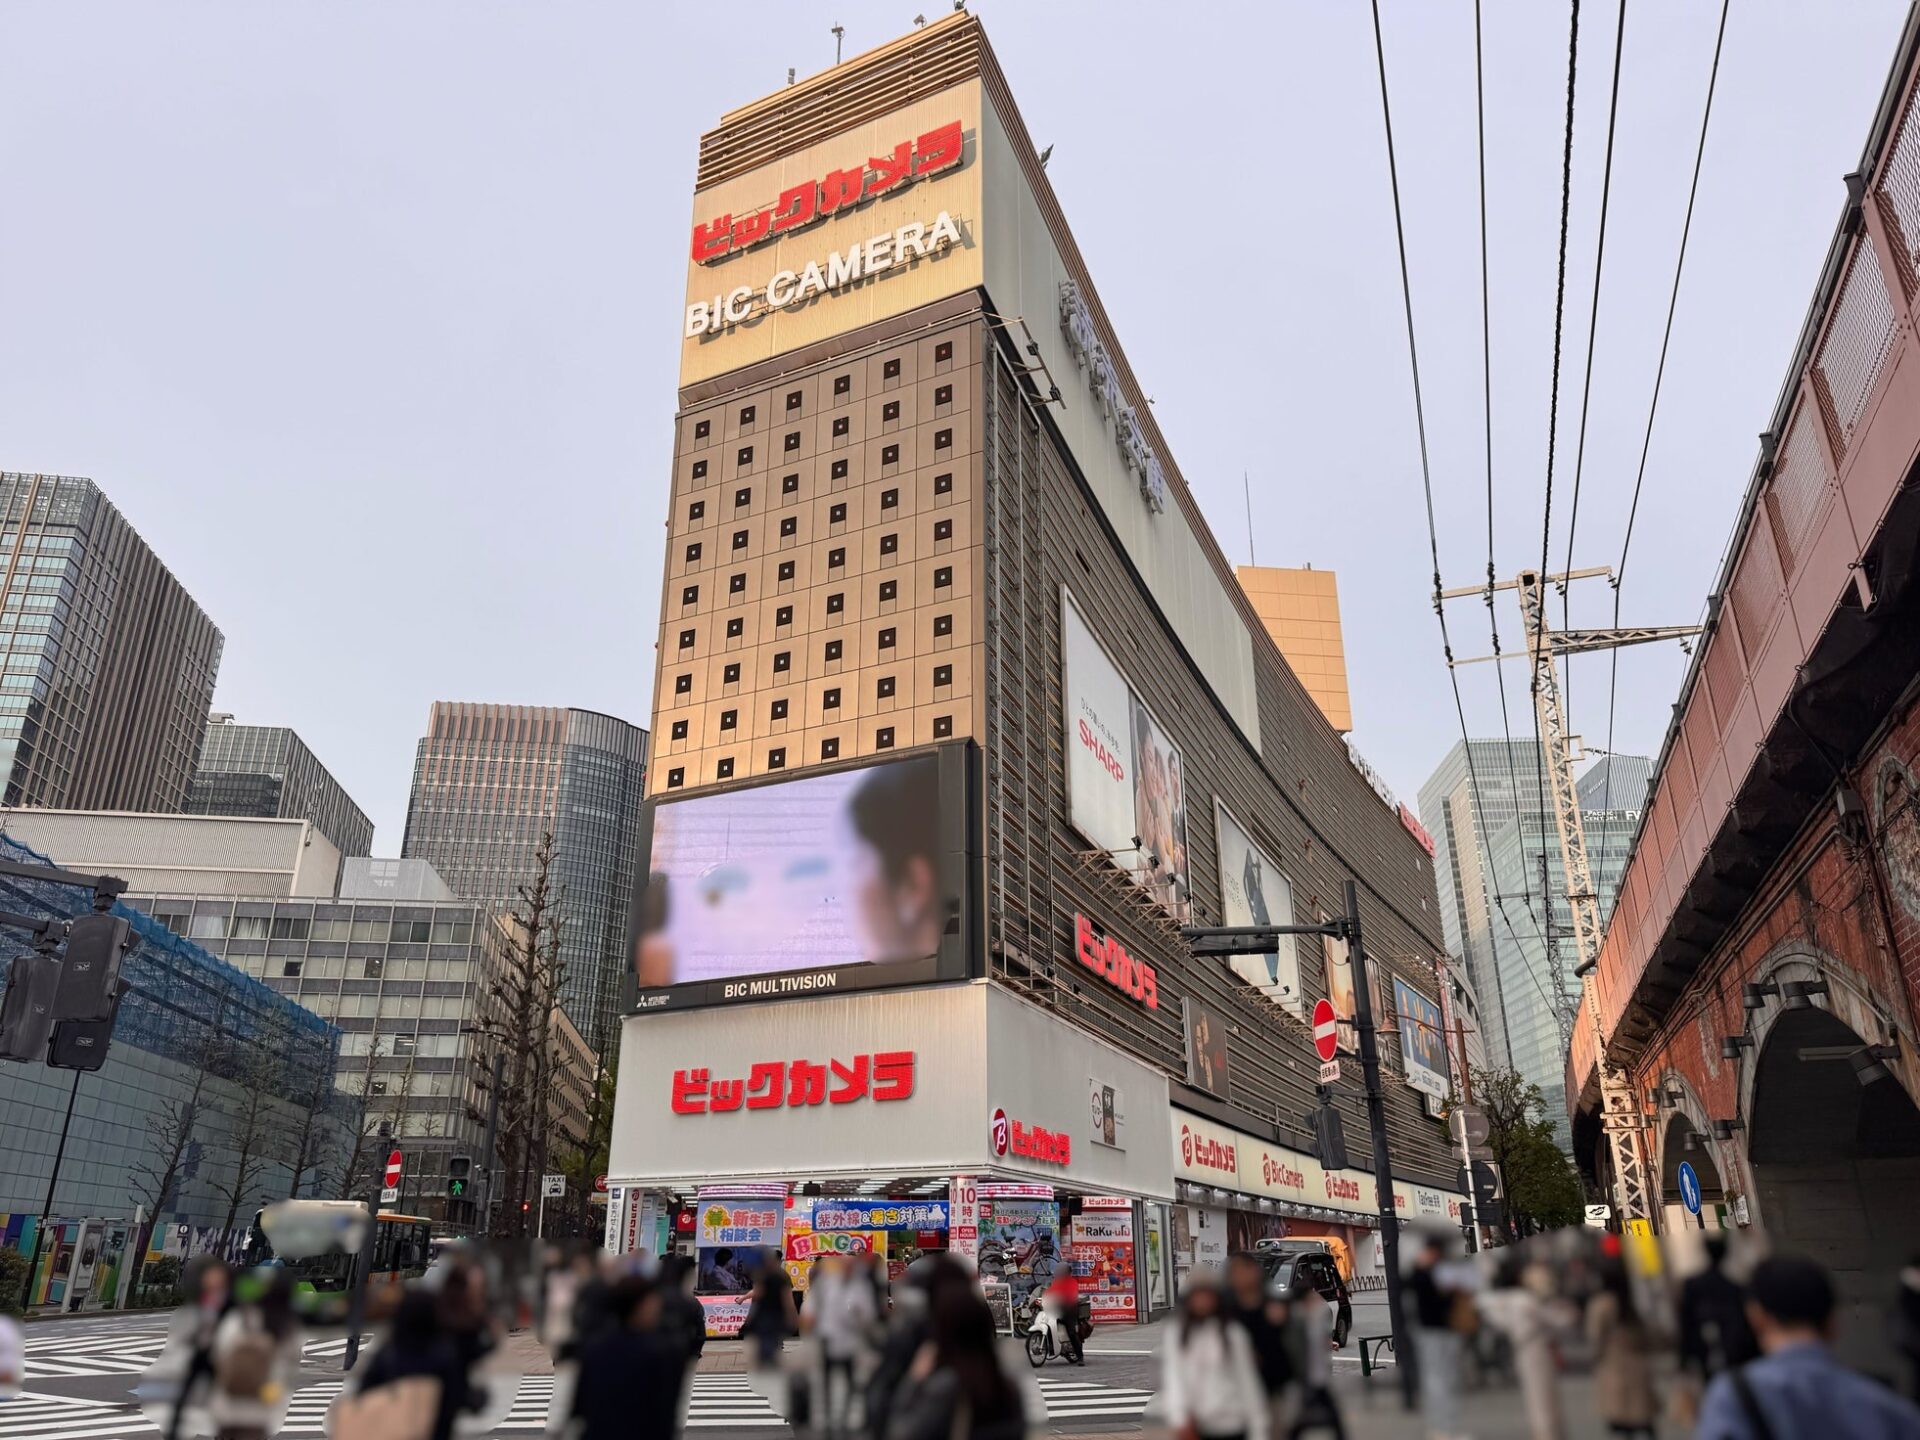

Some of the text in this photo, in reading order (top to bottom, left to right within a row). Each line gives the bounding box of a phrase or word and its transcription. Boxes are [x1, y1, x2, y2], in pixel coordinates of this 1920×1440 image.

[692, 119, 962, 262] ビックカメラ
[686, 210, 961, 338] BIC CAMERA
[1079, 718, 1124, 782] SHARP
[1075, 911, 1158, 1010] ビックカメラ
[724, 973, 837, 998] BIC MULTIVISION
[671, 1051, 914, 1115] ビックカメラ
[1011, 1119, 1070, 1166] ビックカメラ
[1194, 1134, 1236, 1173] ビックカメラ
[1271, 1160, 1304, 1189] BicCamera
[960, 1187, 976, 1204] 10
[962, 1206, 973, 1217] 時
[720, 1227, 762, 1242] 相談会
[732, 1210, 776, 1228] 新生活
[795, 1234, 866, 1257] BINGO
